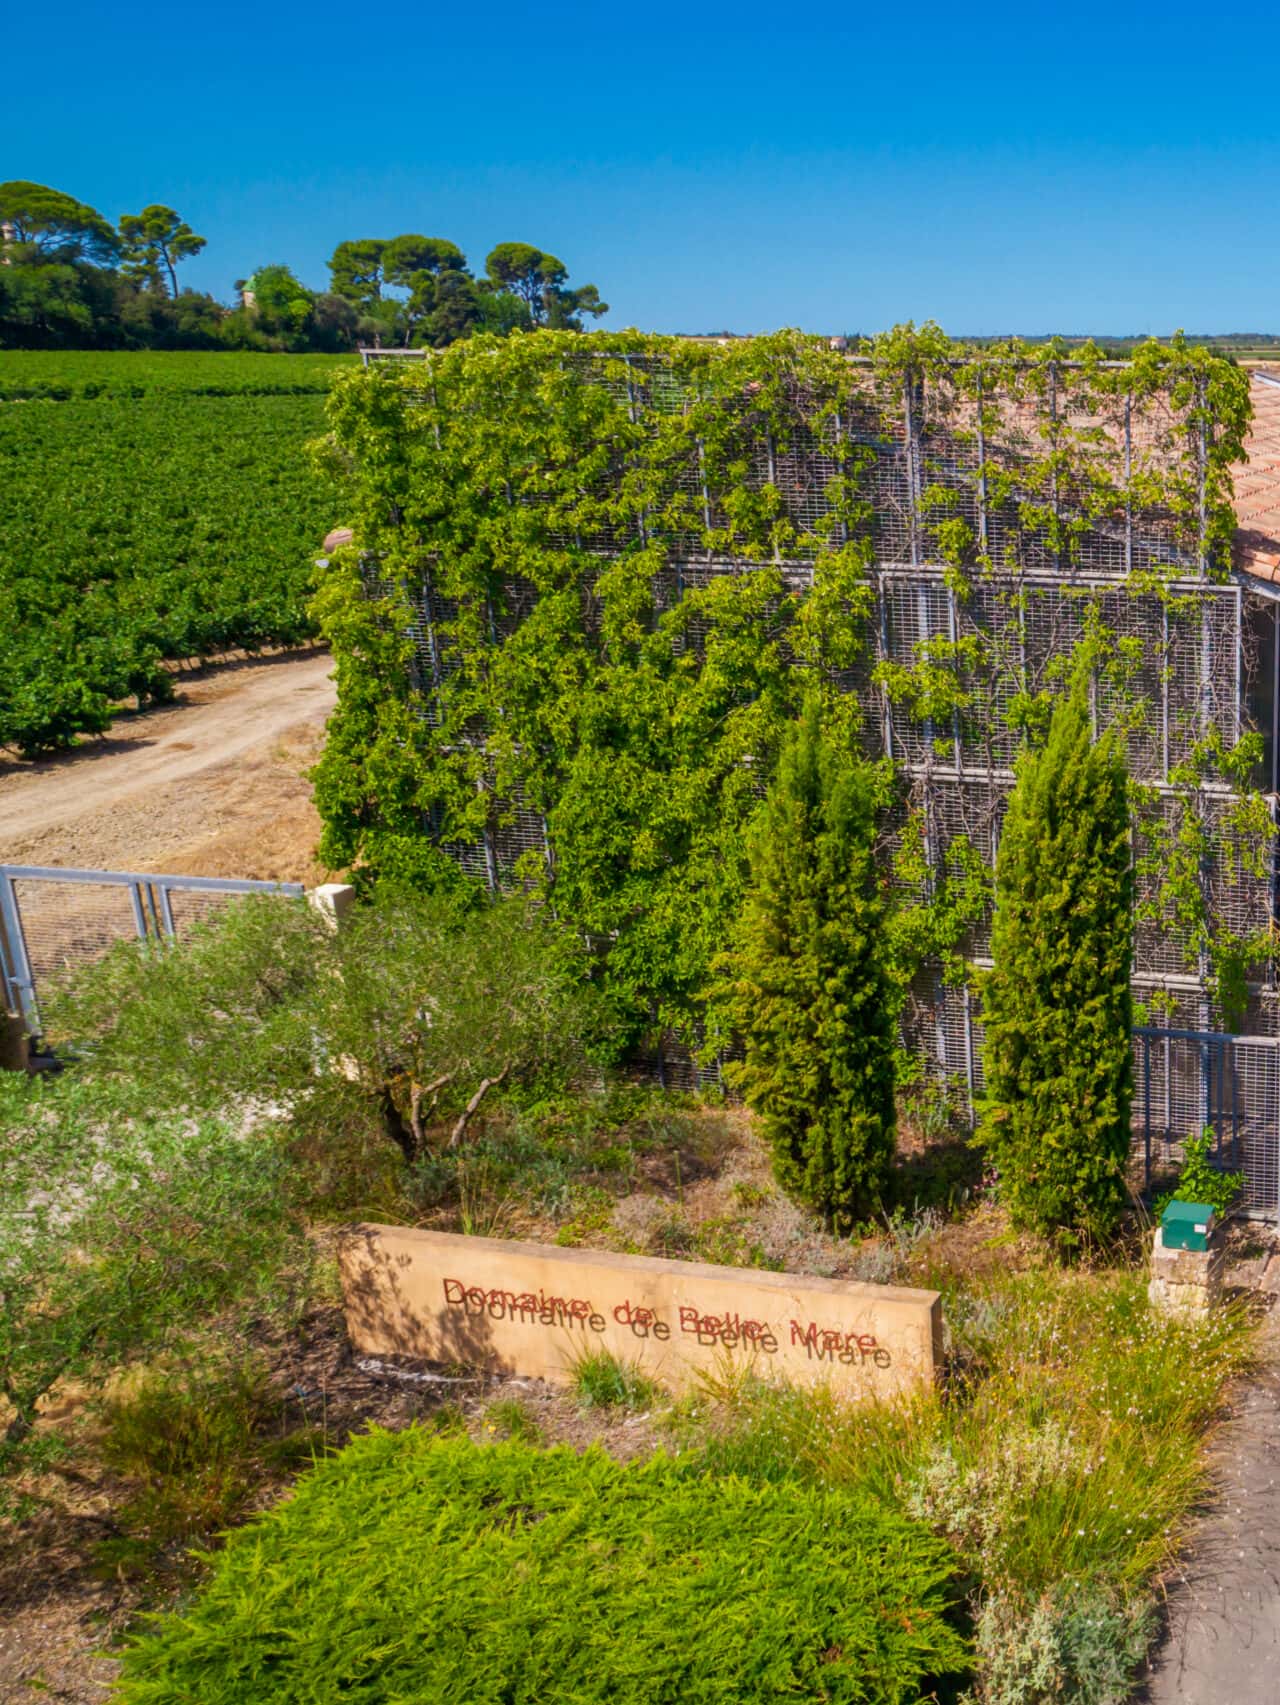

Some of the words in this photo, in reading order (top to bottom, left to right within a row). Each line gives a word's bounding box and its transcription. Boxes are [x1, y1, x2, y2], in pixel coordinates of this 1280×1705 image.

[443, 1278, 590, 1320] Domaine
[613, 1299, 653, 1328] de
[679, 1306, 763, 1341] Belle
[790, 1319, 877, 1354] Mare
